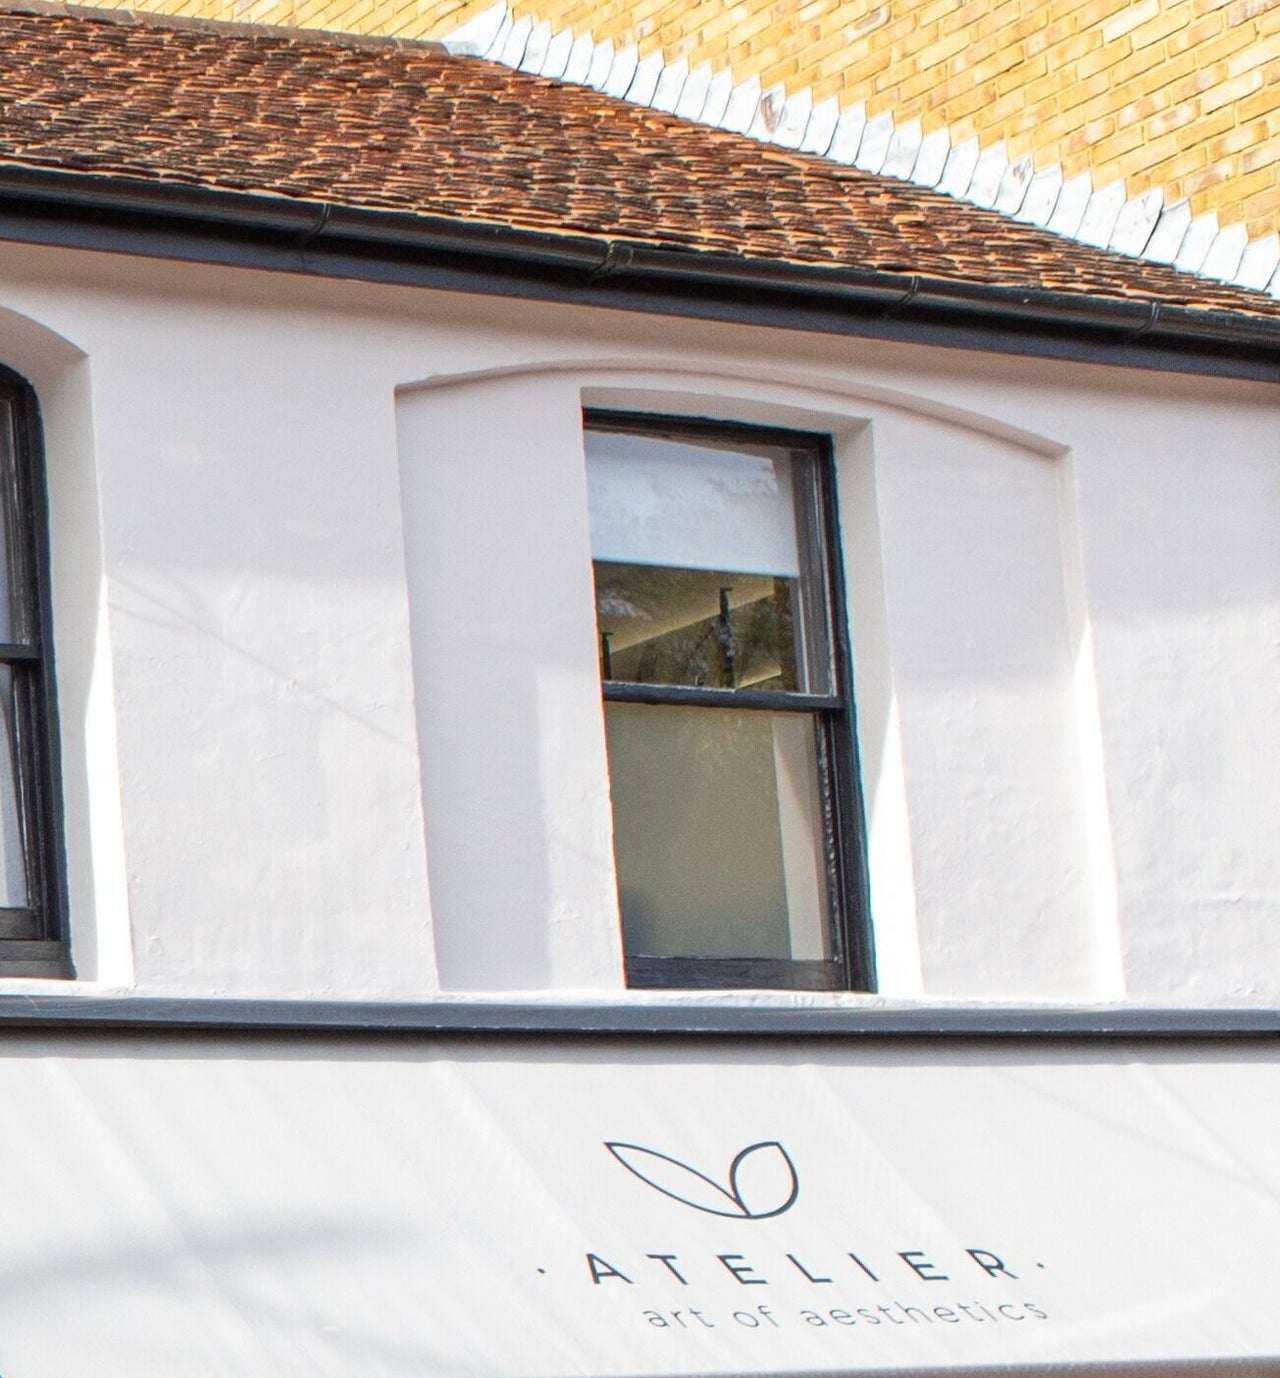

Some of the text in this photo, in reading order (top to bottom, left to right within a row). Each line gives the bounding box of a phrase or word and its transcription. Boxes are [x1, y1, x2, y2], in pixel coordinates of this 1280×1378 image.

[586, 1248, 1020, 1285] ATELIER
[642, 1300, 1049, 1328] art of aesthetics
